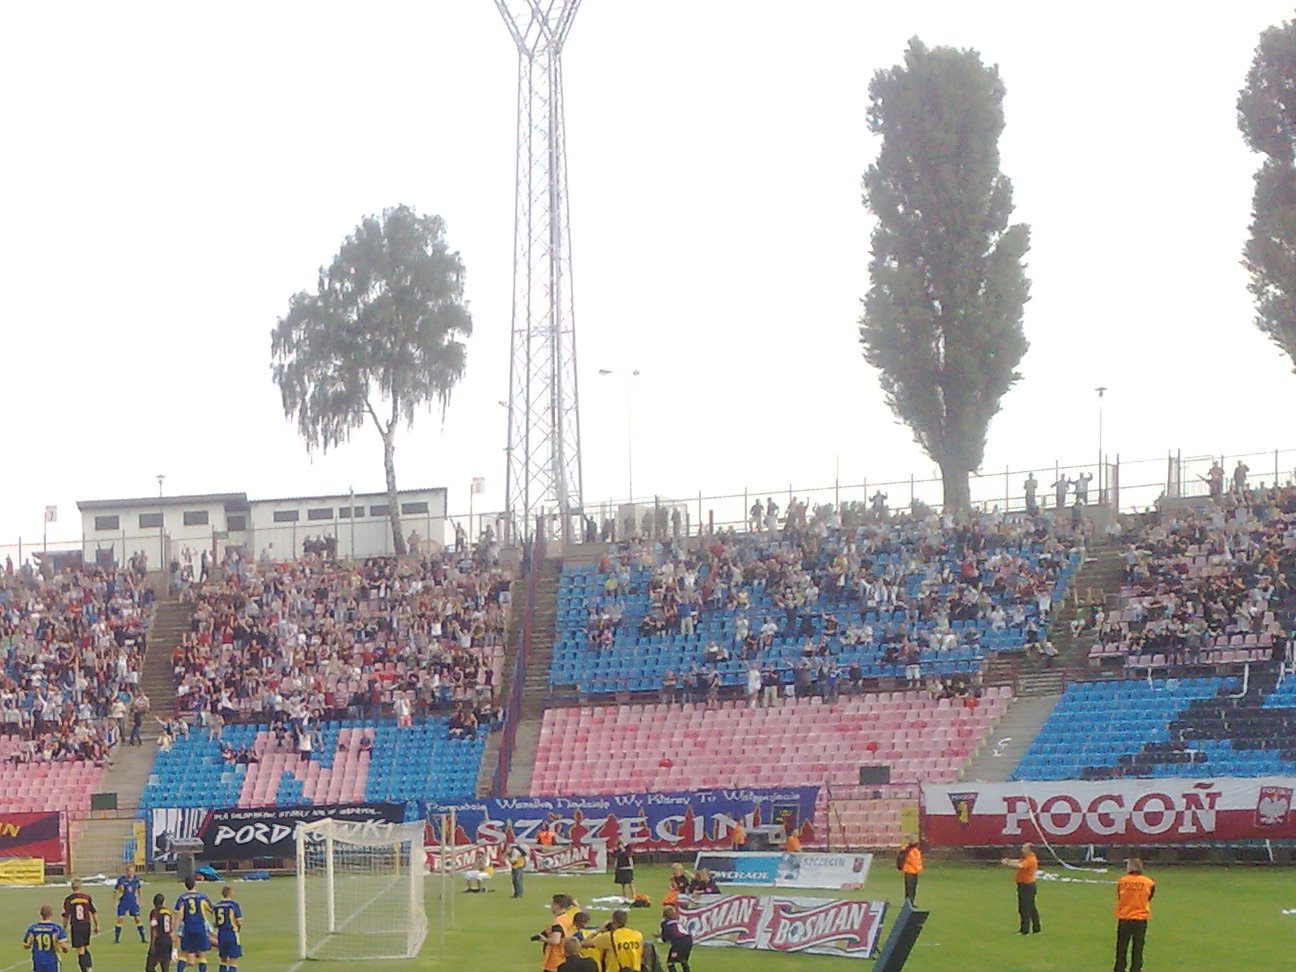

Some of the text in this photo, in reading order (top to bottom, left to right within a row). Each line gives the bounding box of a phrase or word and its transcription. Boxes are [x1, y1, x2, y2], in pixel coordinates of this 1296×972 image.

[537, 844, 590, 869] BOSMAN
[774, 903, 867, 945] BOSMAN
[35, 933, 51, 951] 19
